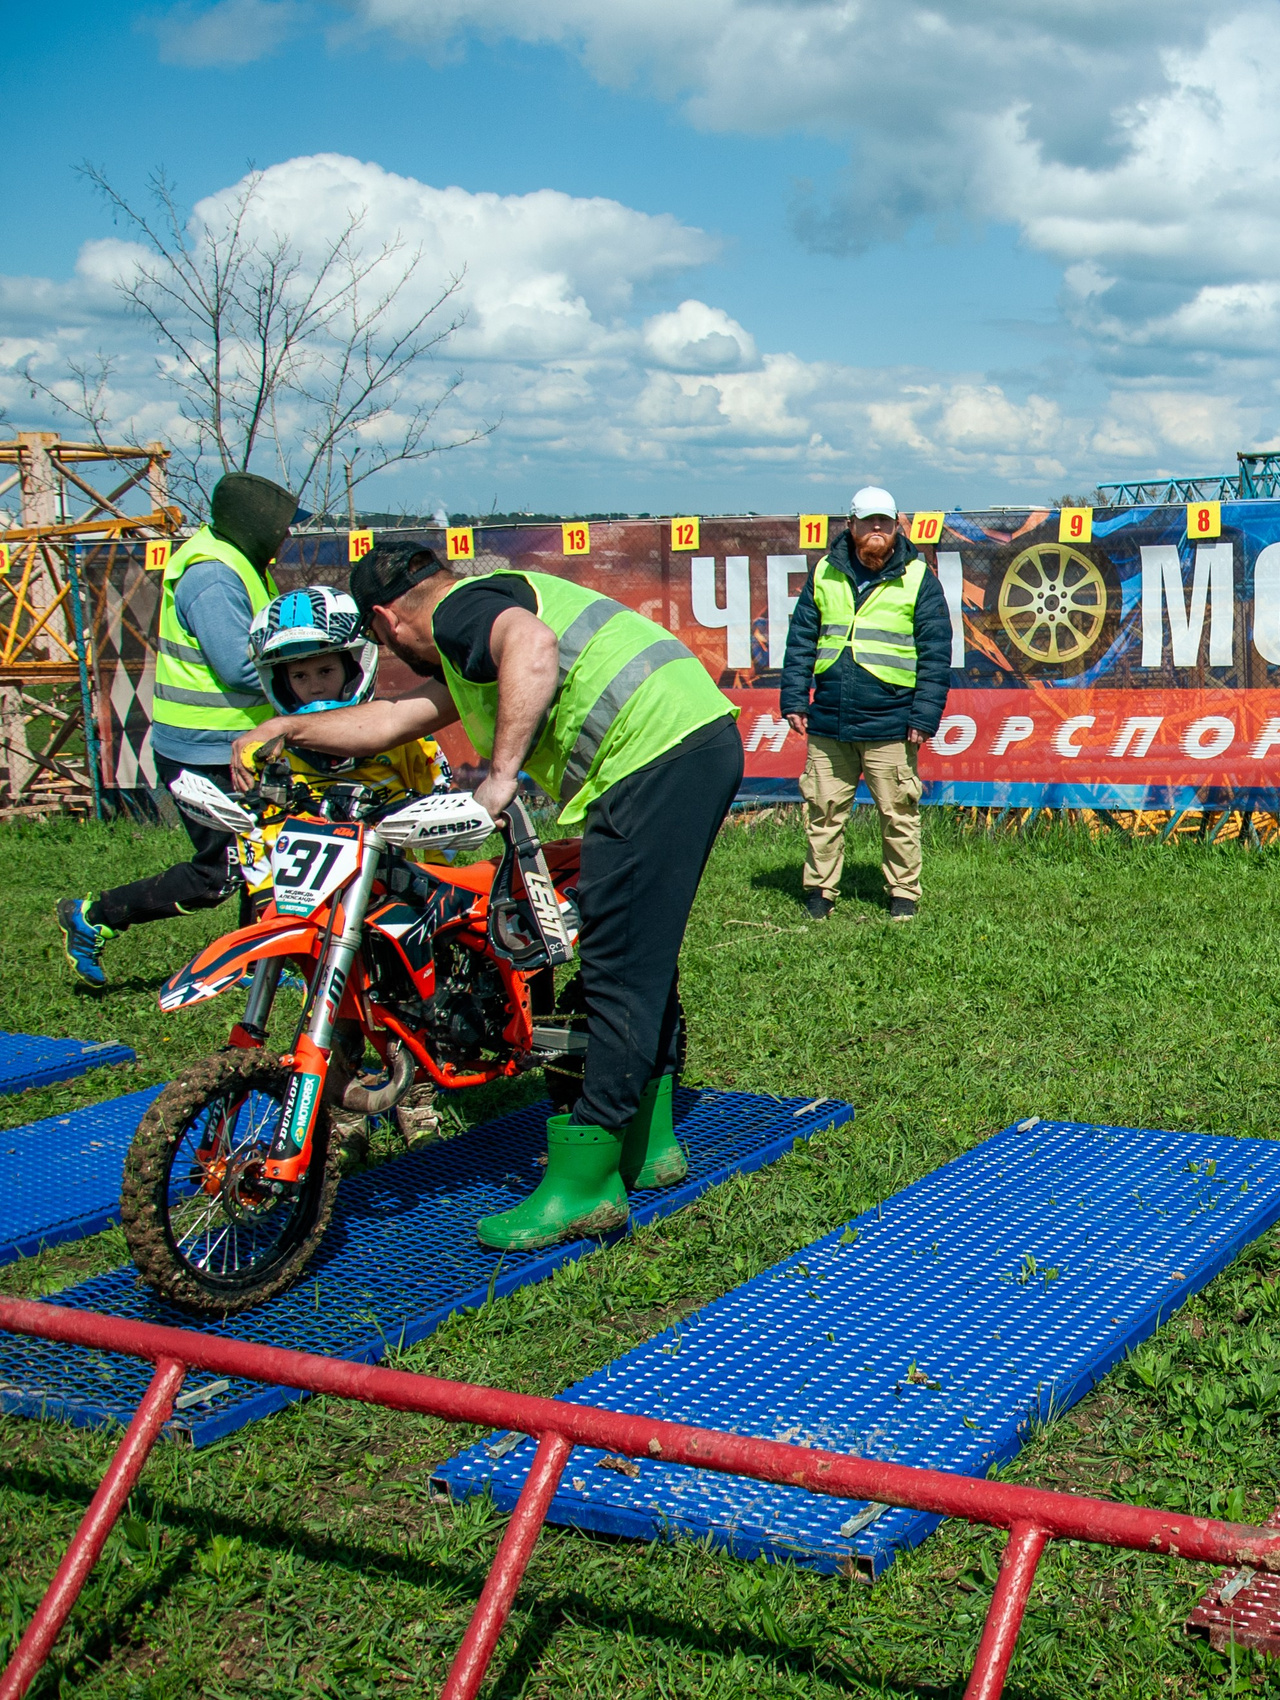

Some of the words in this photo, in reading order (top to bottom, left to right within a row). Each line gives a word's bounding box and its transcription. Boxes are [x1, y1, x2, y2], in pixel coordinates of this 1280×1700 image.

[917, 519, 938, 539] 10
[1070, 514, 1083, 537] 9
[1197, 509, 1210, 532] 8
[567, 529, 586, 550] 13
[676, 524, 694, 545] 12
[805, 522, 821, 543] 11
[352, 537, 371, 557] 15
[451, 535, 470, 555] 14
[151, 547, 166, 566] 17
[332, 826, 356, 838] KTM
[418, 818, 483, 838] ACERBIS
[275, 838, 344, 891] 31
[279, 1076, 300, 1140] DUNLOP
[296, 1077, 316, 1127] MOTOREX
